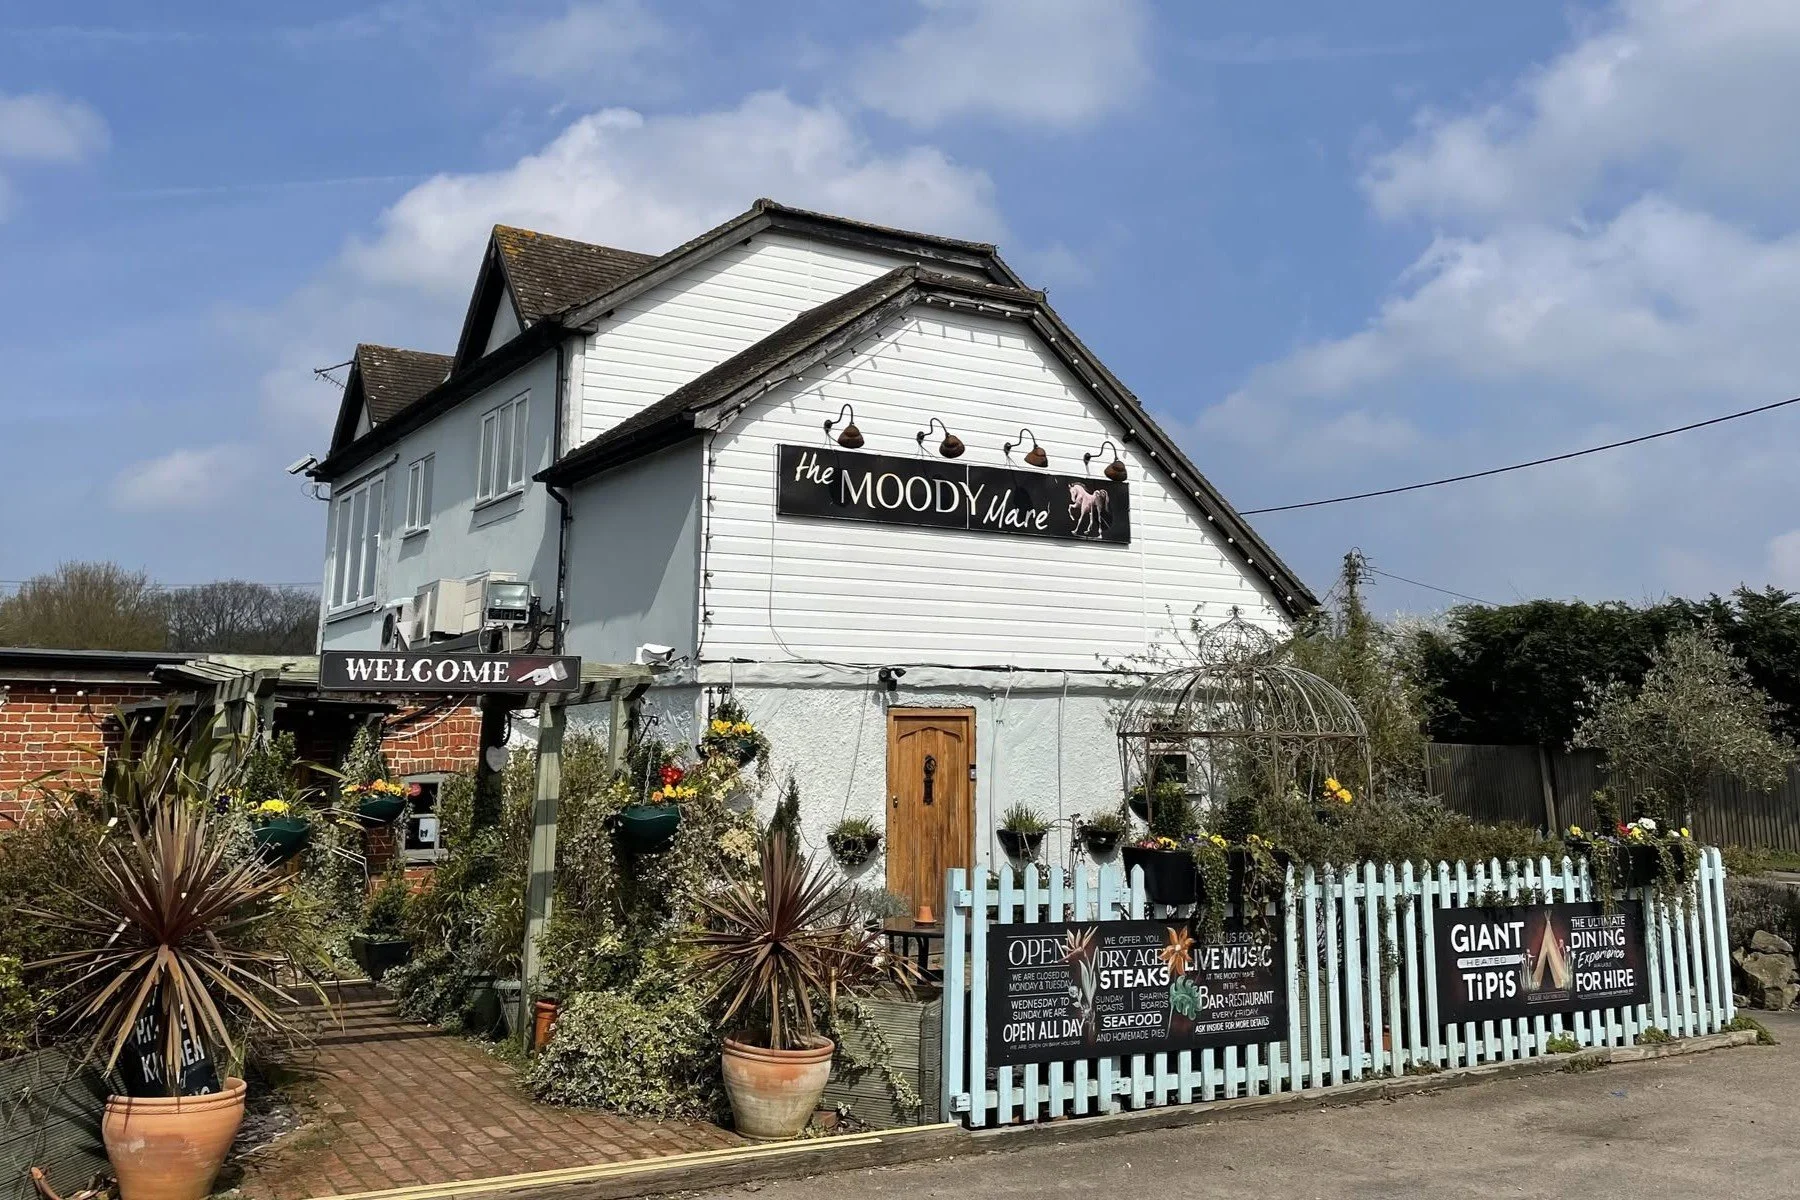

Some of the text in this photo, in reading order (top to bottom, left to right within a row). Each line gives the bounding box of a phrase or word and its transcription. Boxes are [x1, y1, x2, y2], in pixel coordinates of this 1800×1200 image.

[795, 451, 1049, 530] the MOODY Mare
[345, 657, 509, 683] WELCOME
[1571, 916, 1626, 928] THE ULTIMATE
[1104, 937, 1116, 945] WE
[1118, 935, 1141, 945] OFFER
[1225, 932, 1237, 944] US
[1450, 921, 1525, 953] GIANT
[1570, 928, 1626, 949] DINING
[1009, 938, 1069, 965] OPEN
[1184, 945, 1272, 971] LIVE MUSIC
[1577, 947, 1625, 969] Experience
[1100, 950, 1131, 968] DRY
[1466, 956, 1507, 967] HEATED
[1012, 970, 1070, 982] WE ARE CLOSED ON
[1100, 967, 1170, 989] STEAKS
[1575, 968, 1634, 993] FOR HIRE
[1008, 981, 1038, 992] MONDAY
[1045, 979, 1074, 990] TUESDAY
[1011, 996, 1070, 1009] WEDNESDAY TO
[1095, 995, 1124, 1004] SUNDAY
[1139, 991, 1169, 1001] SHARING
[1199, 986, 1224, 1009] BAR
[1229, 991, 1274, 1007] RESTAURANT
[1096, 1002, 1124, 1012] ROASTS
[1140, 1000, 1169, 1010] BOARDS
[1042, 1008, 1053, 1018] WE
[1211, 1008, 1258, 1019] EVERY FRIDAY
[1103, 1014, 1162, 1027] SEAFOOD
[1194, 1016, 1270, 1034] ASK INSIDE FOR MORE DETAILS
[1003, 1018, 1085, 1043] OPEN ALL DAY
[1096, 1028, 1166, 1043] AND HOMEMADE PIES
